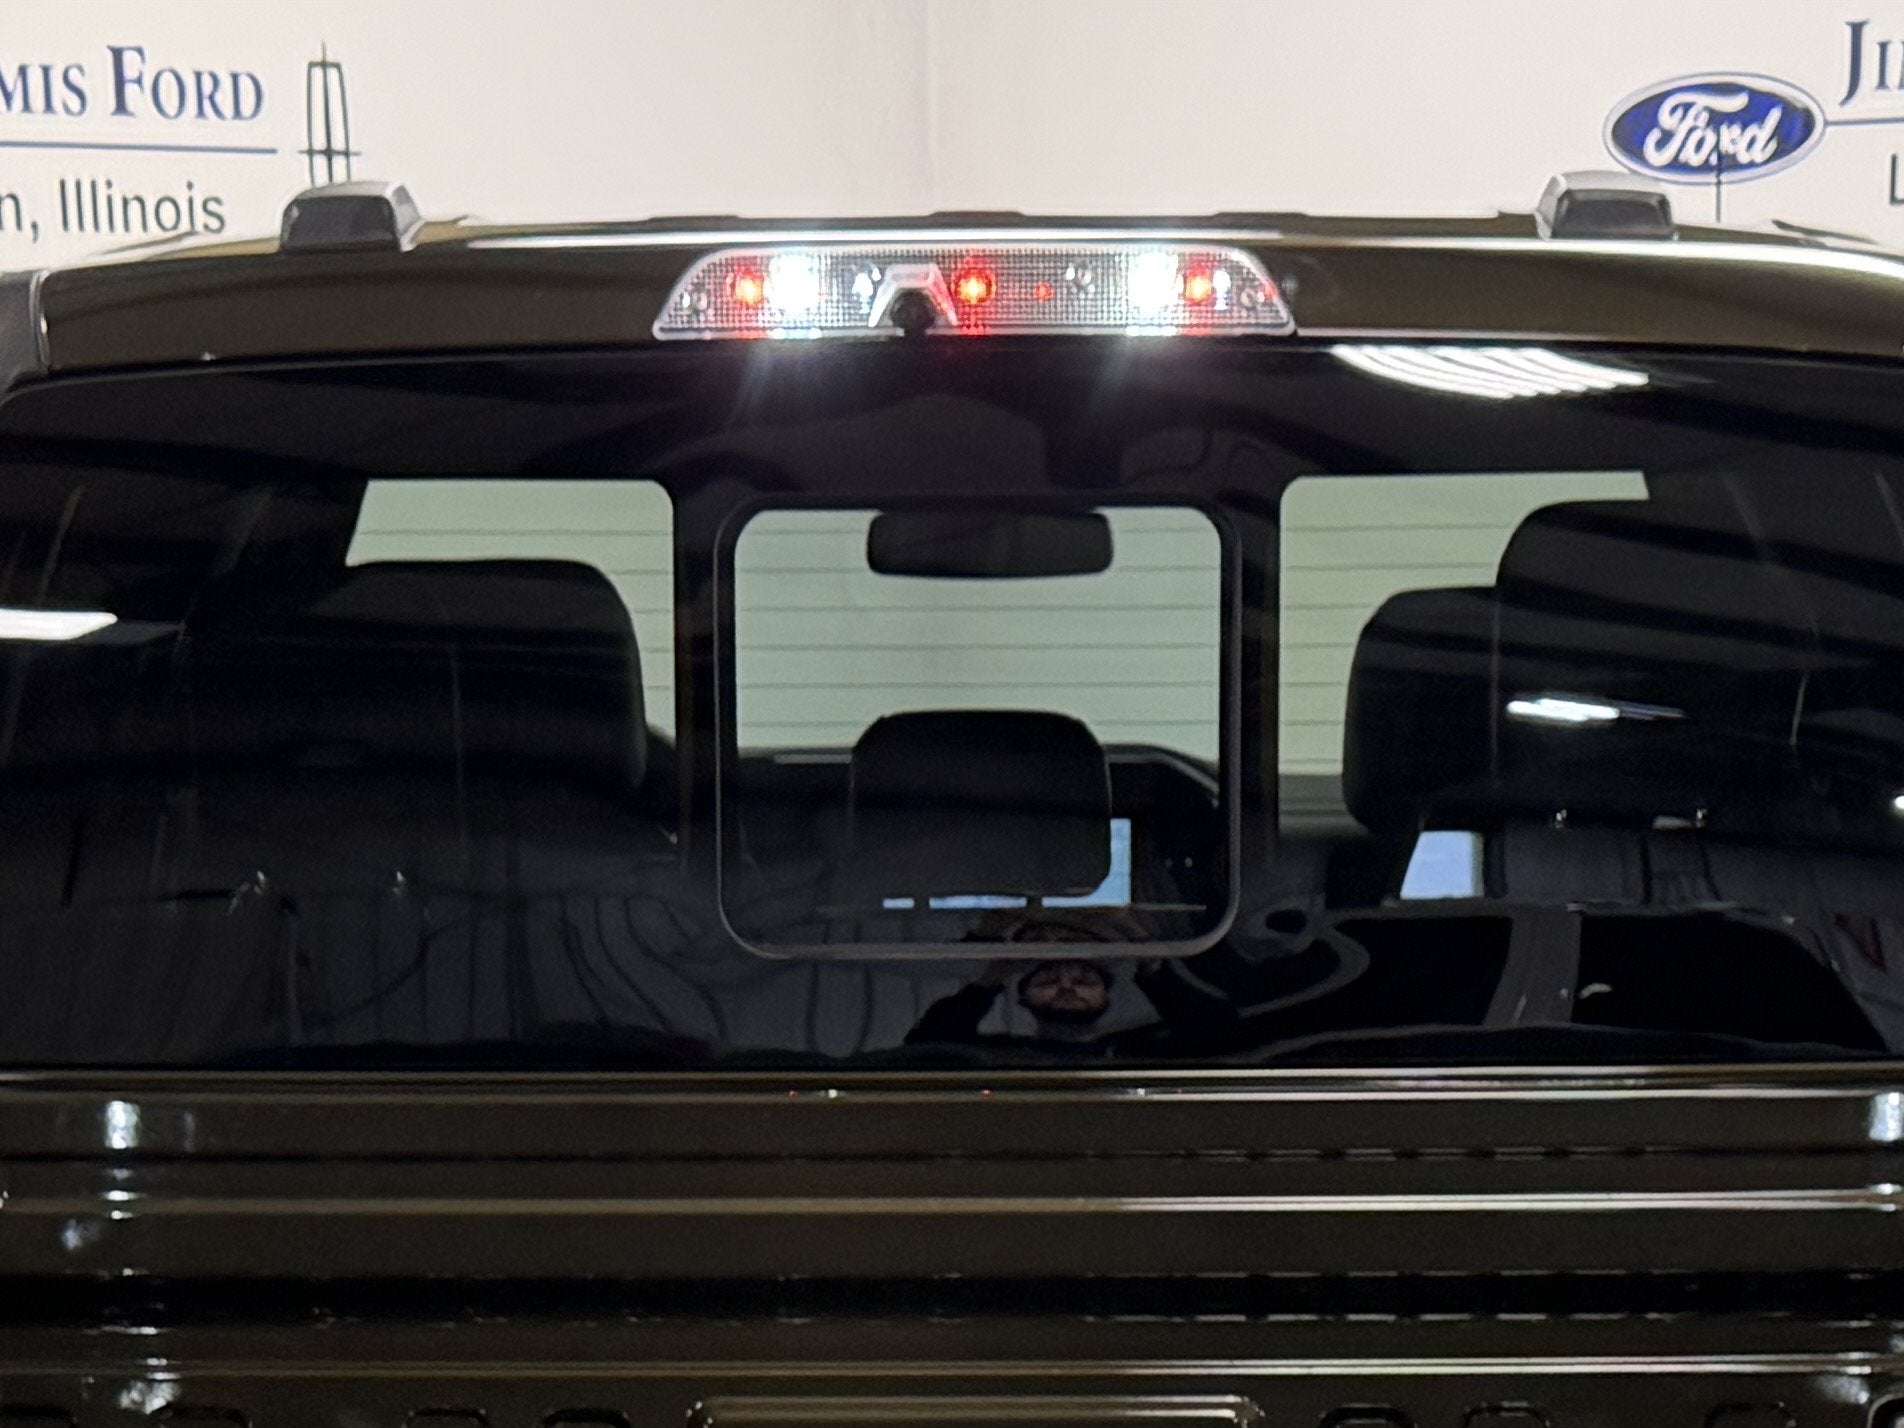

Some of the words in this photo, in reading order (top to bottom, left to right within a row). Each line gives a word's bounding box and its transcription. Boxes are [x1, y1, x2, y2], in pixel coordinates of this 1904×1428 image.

[107, 45, 264, 122] FORD
[1643, 90, 1781, 169] Ford
[58, 177, 228, 236] Illinois
